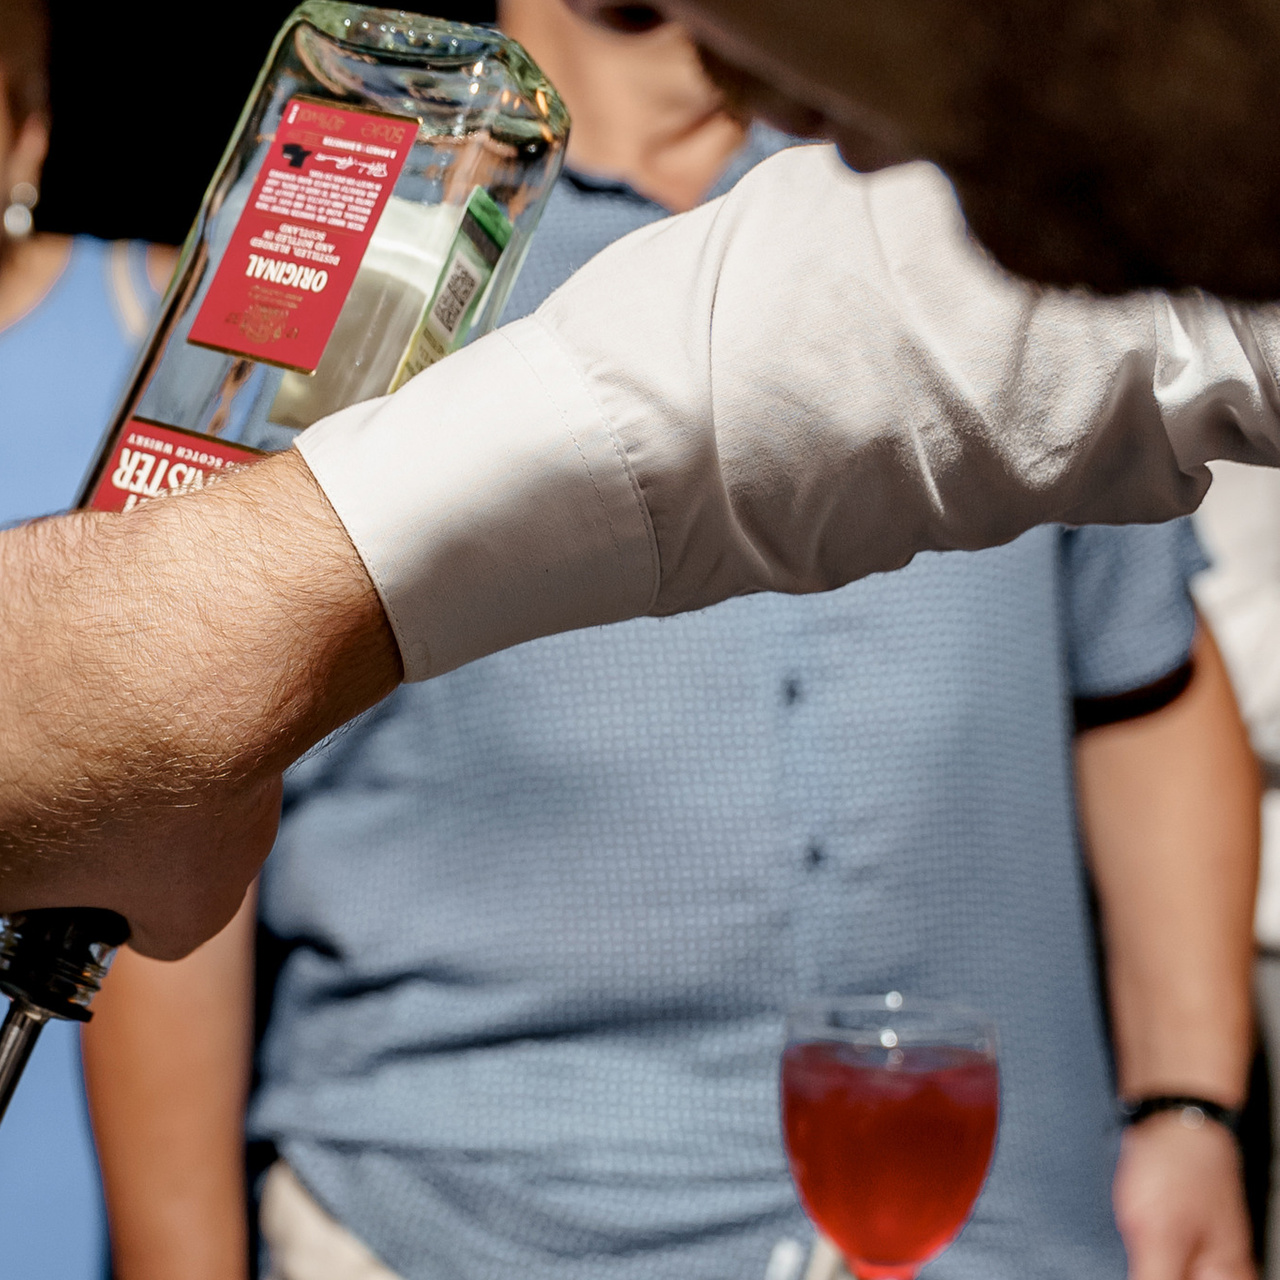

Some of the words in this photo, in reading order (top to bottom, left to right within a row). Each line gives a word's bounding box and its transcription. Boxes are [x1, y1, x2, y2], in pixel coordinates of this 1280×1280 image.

[314, 242, 336, 254] AND
[245, 253, 329, 293] ORIGINAL
[127, 433, 173, 455] WHISKY
[175, 445, 224, 468] SCOTCH
